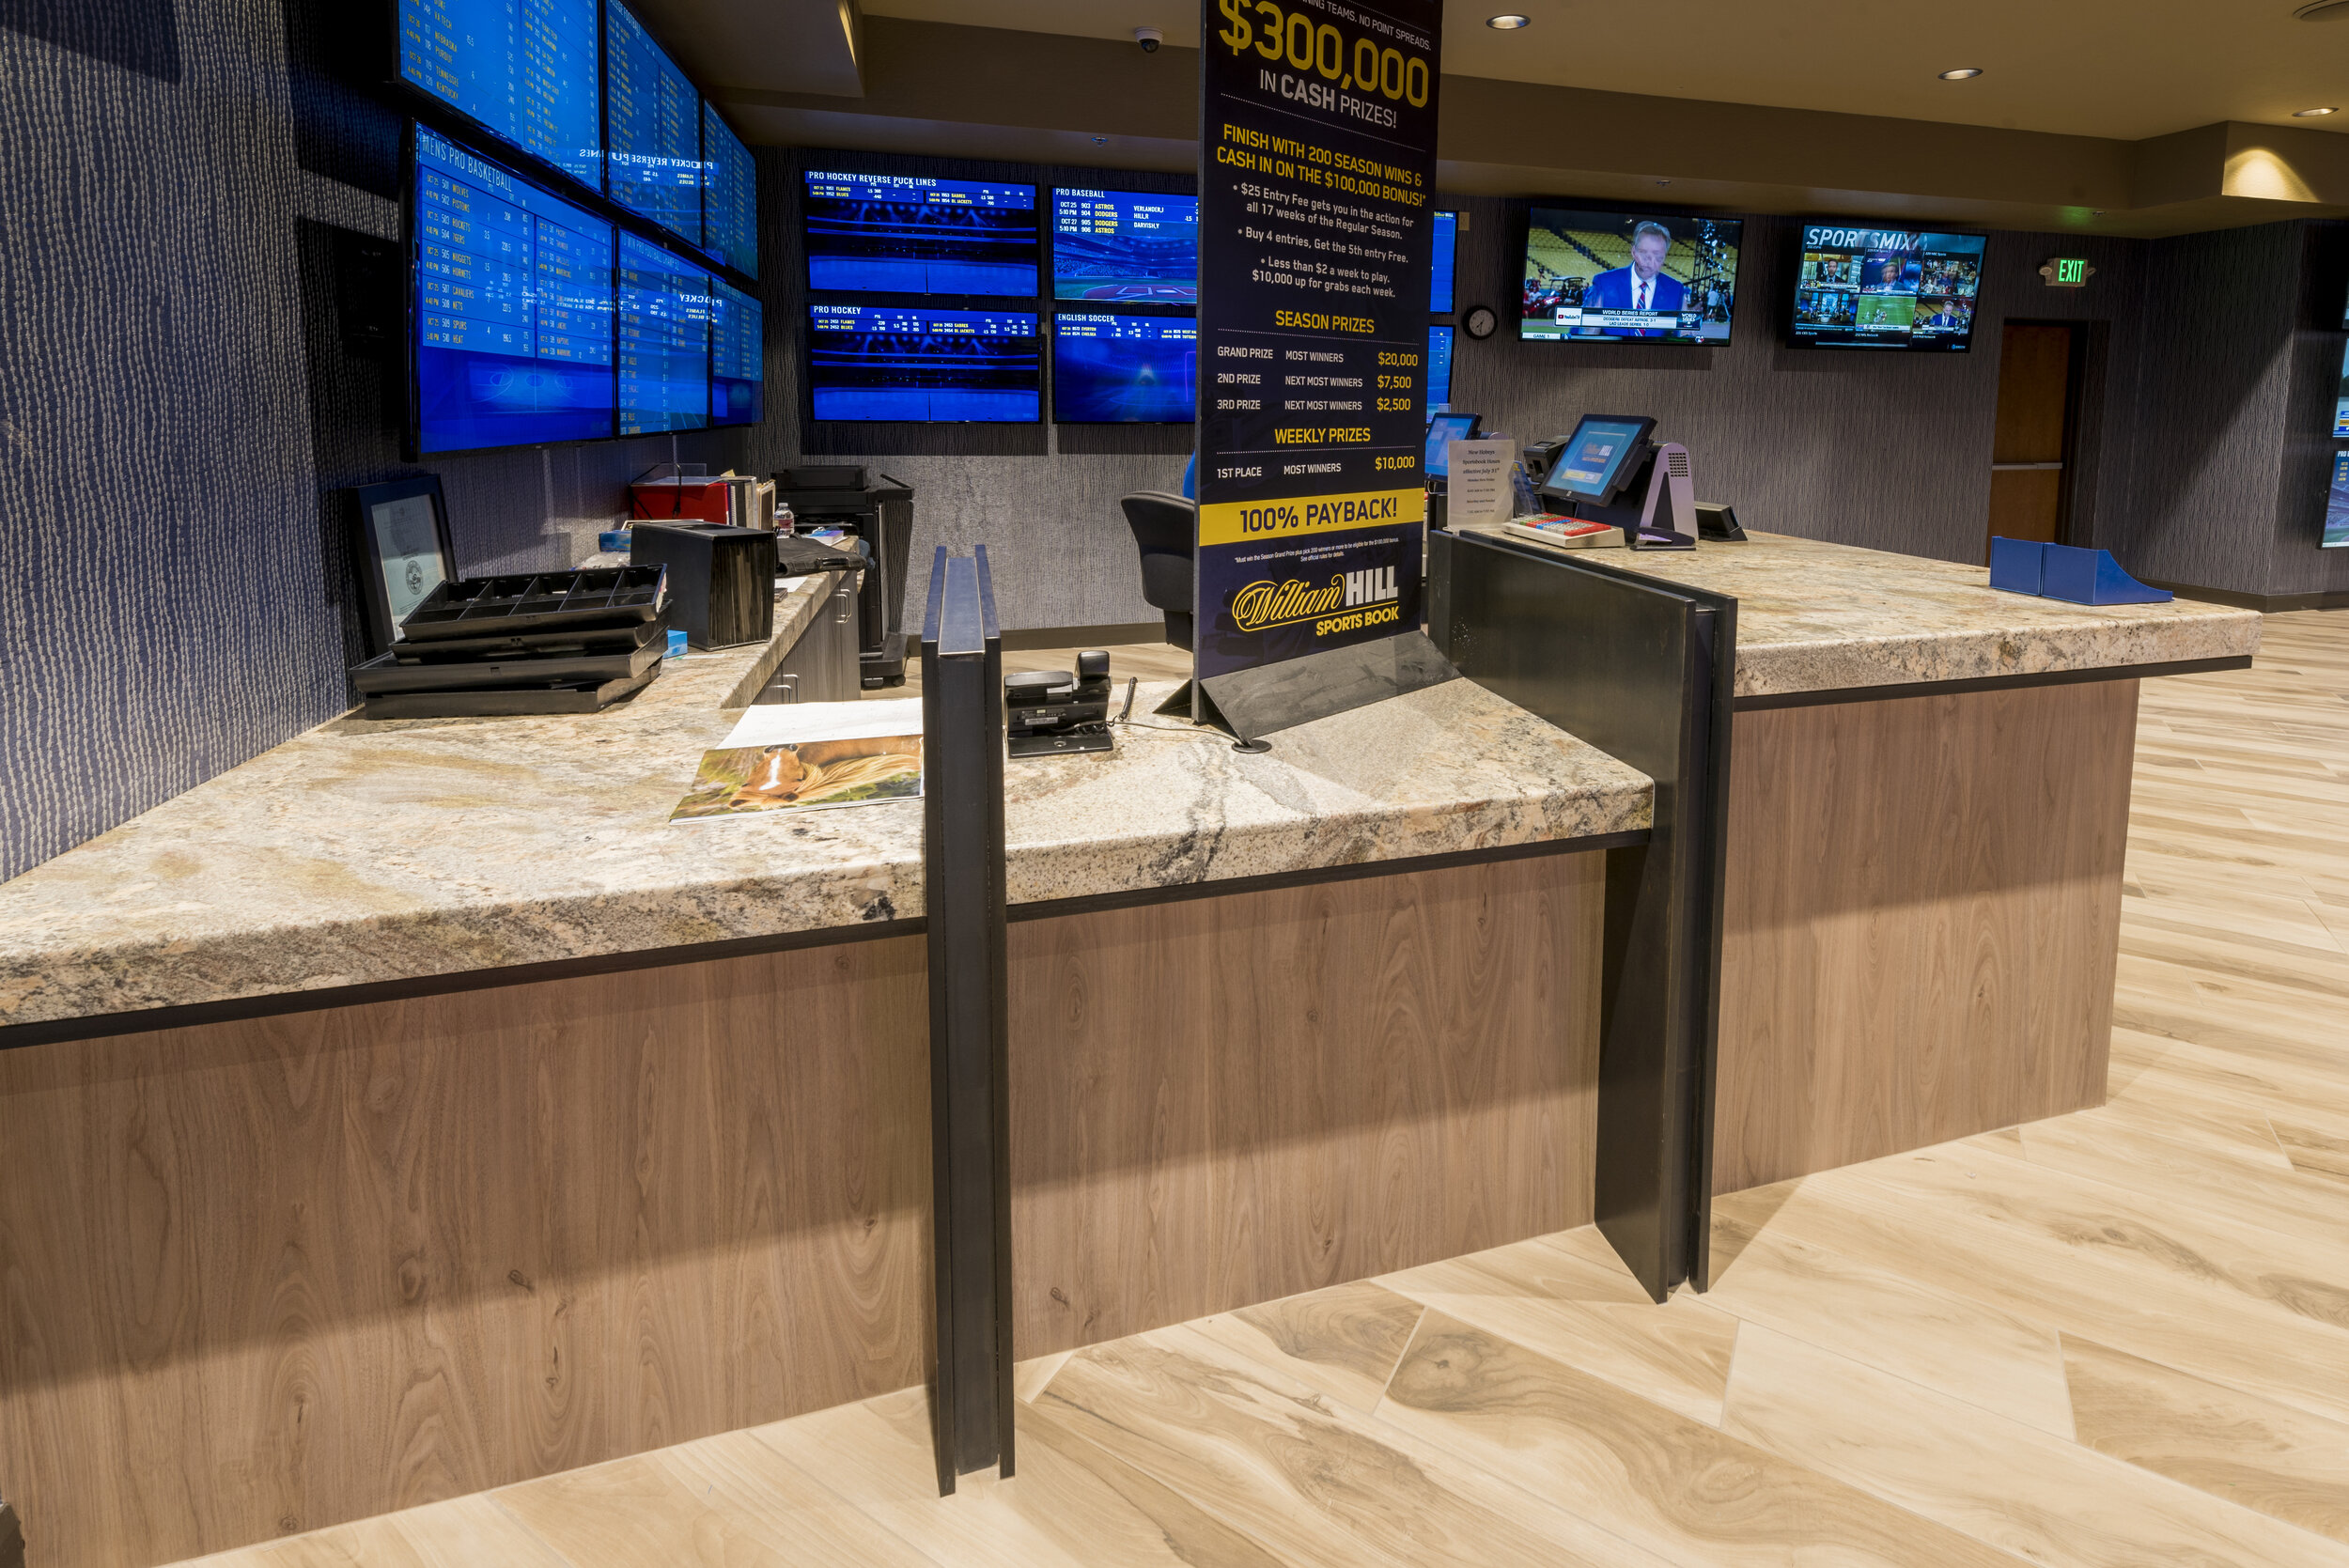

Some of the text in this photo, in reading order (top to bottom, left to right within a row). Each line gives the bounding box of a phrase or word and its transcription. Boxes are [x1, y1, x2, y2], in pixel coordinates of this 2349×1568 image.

[1327, 1, 1357, 23] TEAMS.
[1360, 14, 1370, 26] NO
[1373, 20, 1393, 36] POINT
[1395, 29, 1431, 51] SPREADS.
[1219, 0, 1429, 108] $300,000
[1260, 69, 1397, 128] IN CASH PRIZES!
[423, 135, 511, 192] MENS PRO BASKETBALL
[1223, 123, 1422, 187] FINISH WITH 200 SEASON WINS &
[809, 171, 824, 179] PRO
[827, 173, 856, 181] HOCKEY
[860, 175, 891, 183] REVERSE
[894, 177, 913, 185] PUCK
[1217, 147, 1255, 169] CASH
[1259, 156, 1272, 173] IN
[1276, 161, 1294, 179] ON
[1298, 165, 1321, 184] THE
[1325, 171, 1380, 196] $100,000
[1072, 190, 1105, 198] BASEBALL
[1241, 182, 1414, 227] $25 Entry Fee gets you in the action for
[1247, 202, 1402, 240] all 17 weeks of the Regular Season.
[1246, 226, 1408, 263] Buy 4 entries, Get the 5th entry Free.
[1252, 269, 1395, 298] $10,000 up for grabs each week.
[1268, 256, 1290, 269] Less
[1293, 259, 1314, 272] than
[1316, 263, 1328, 274] $2
[1337, 265, 1359, 279] week
[1361, 271, 1369, 280] to
[1372, 272, 1390, 285] play.
[2058, 259, 2084, 283] EXIT
[1275, 310, 1375, 334] SEASON PRIZES
[1218, 346, 1418, 366] GRAND PRIZE MOST WINNERS $20,000
[1218, 374, 1411, 389] 2ND PRIZE NEXT MOST WINNERS $7,500
[1217, 397, 1410, 411] 3RD PRIZE NEXT MOST WINNERS $2,500
[1275, 427, 1371, 443] WEEKLY PRIZES
[1218, 456, 1415, 478] 1ST PLACE MOST WINNERS $10,000
[1240, 497, 1397, 533] 100% PAYBACK!
[1232, 566, 1398, 631] William HILL
[1316, 606, 1399, 636] SPORTS BOOK
